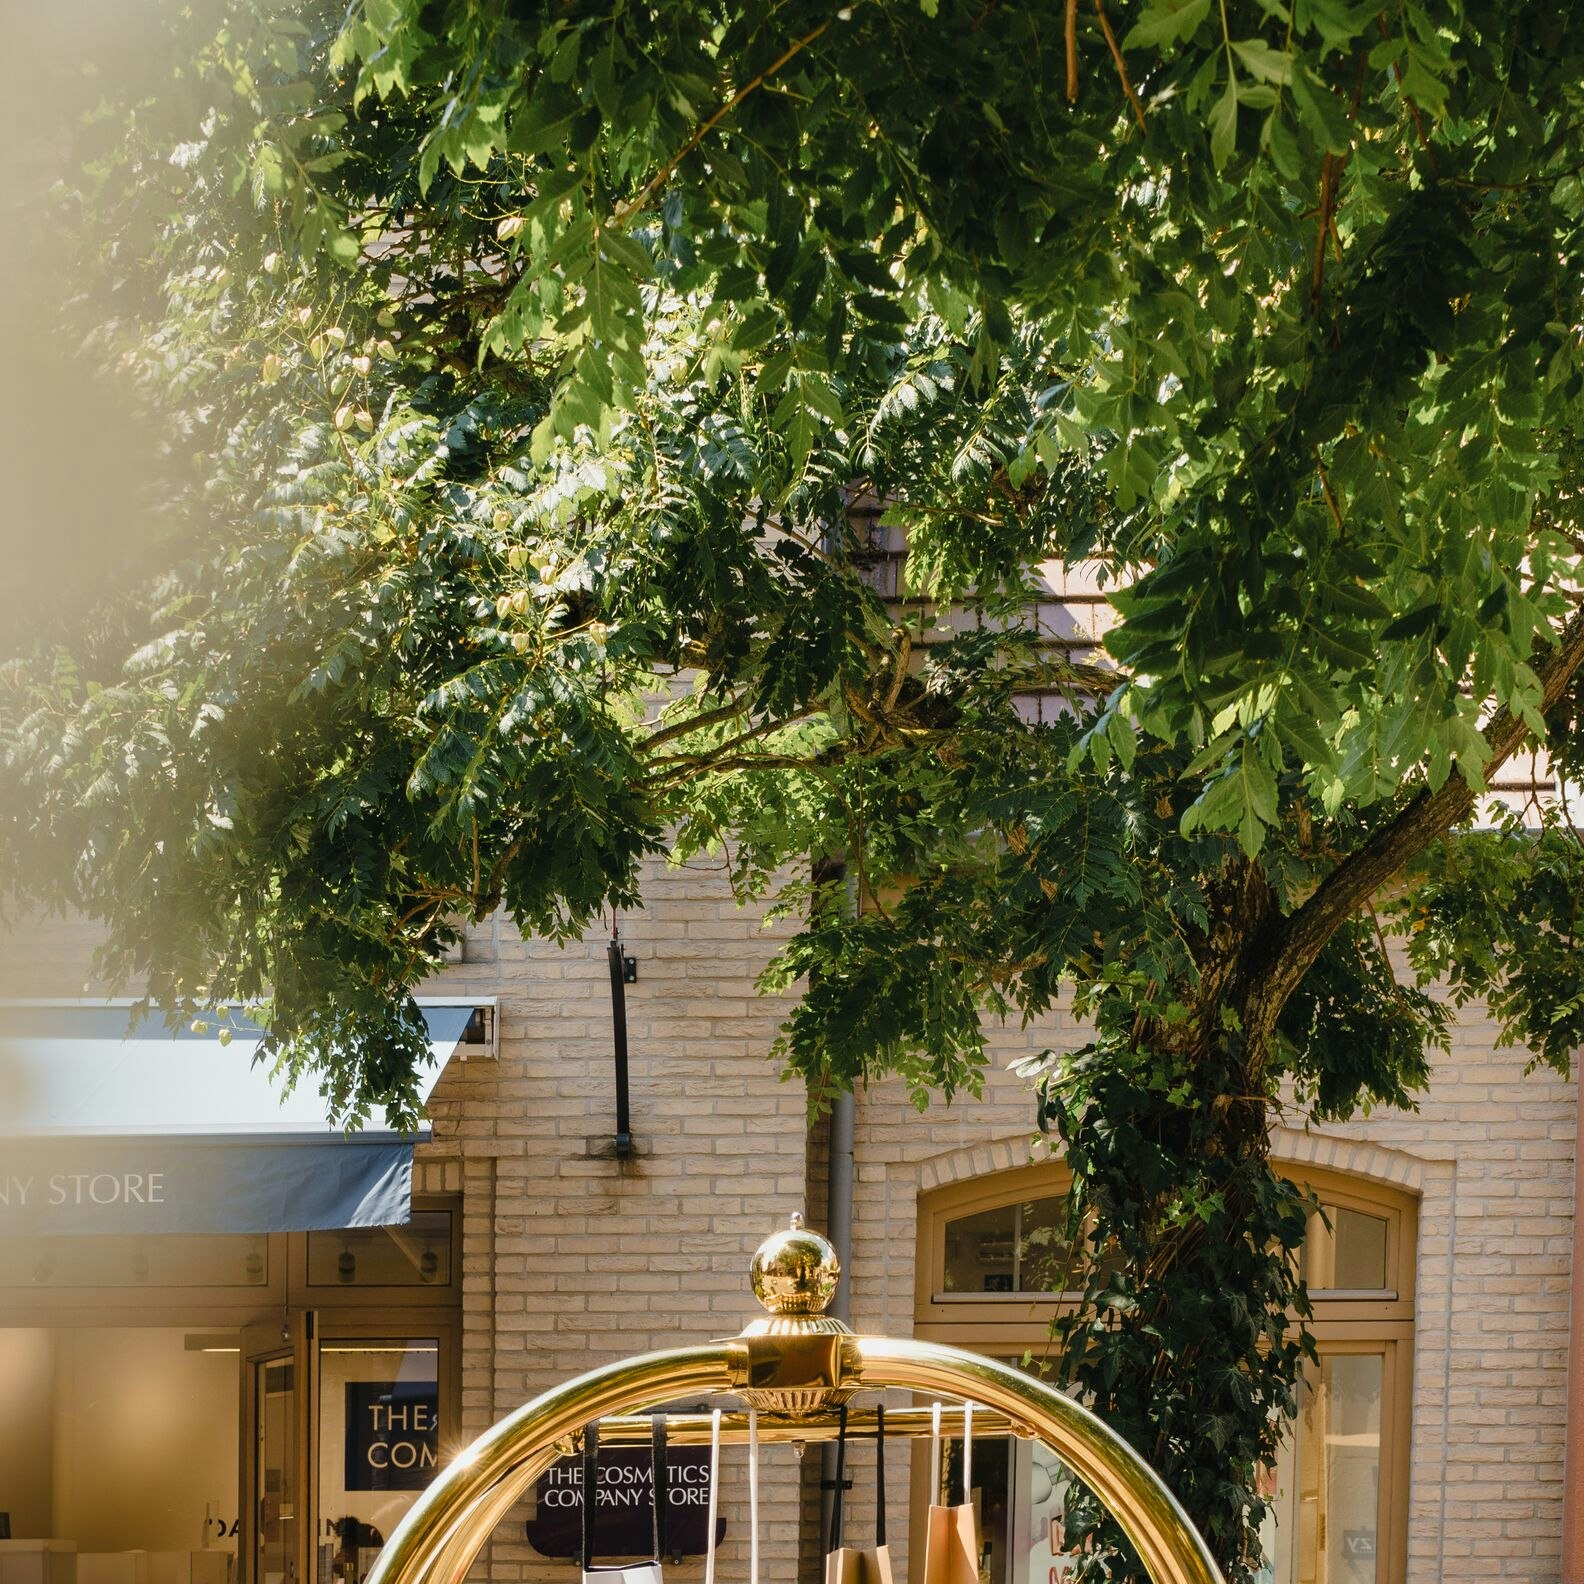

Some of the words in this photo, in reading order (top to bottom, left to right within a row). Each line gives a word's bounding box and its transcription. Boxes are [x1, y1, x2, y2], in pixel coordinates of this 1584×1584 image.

[48, 1173, 164, 1205] STORE
[368, 1405, 428, 1431] THE
[547, 1467, 583, 1485] THE
[596, 1465, 709, 1484] COSMTICS
